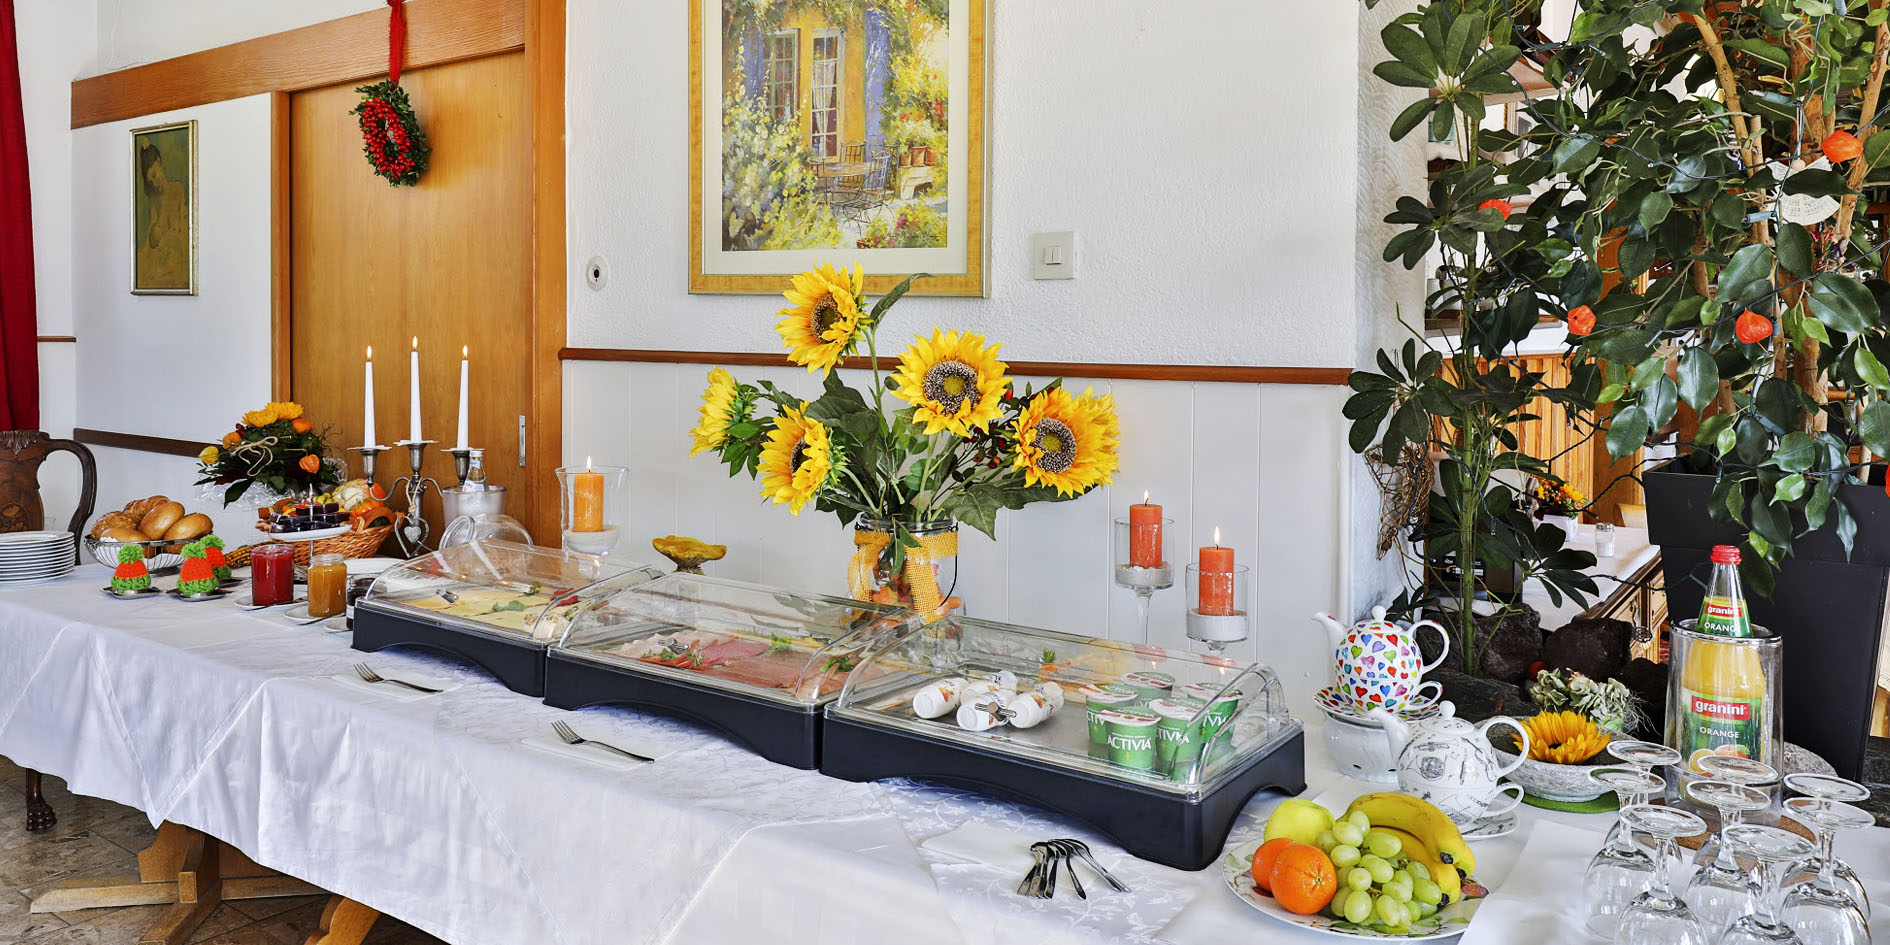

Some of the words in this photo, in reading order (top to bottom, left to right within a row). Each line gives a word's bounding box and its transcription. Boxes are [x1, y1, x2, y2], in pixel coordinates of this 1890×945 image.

[1704, 621, 1740, 632] ORANG
[1695, 700, 1745, 716] granini
[1699, 726, 1740, 739] ORANGE
[1107, 734, 1152, 751] ACTIVIA
